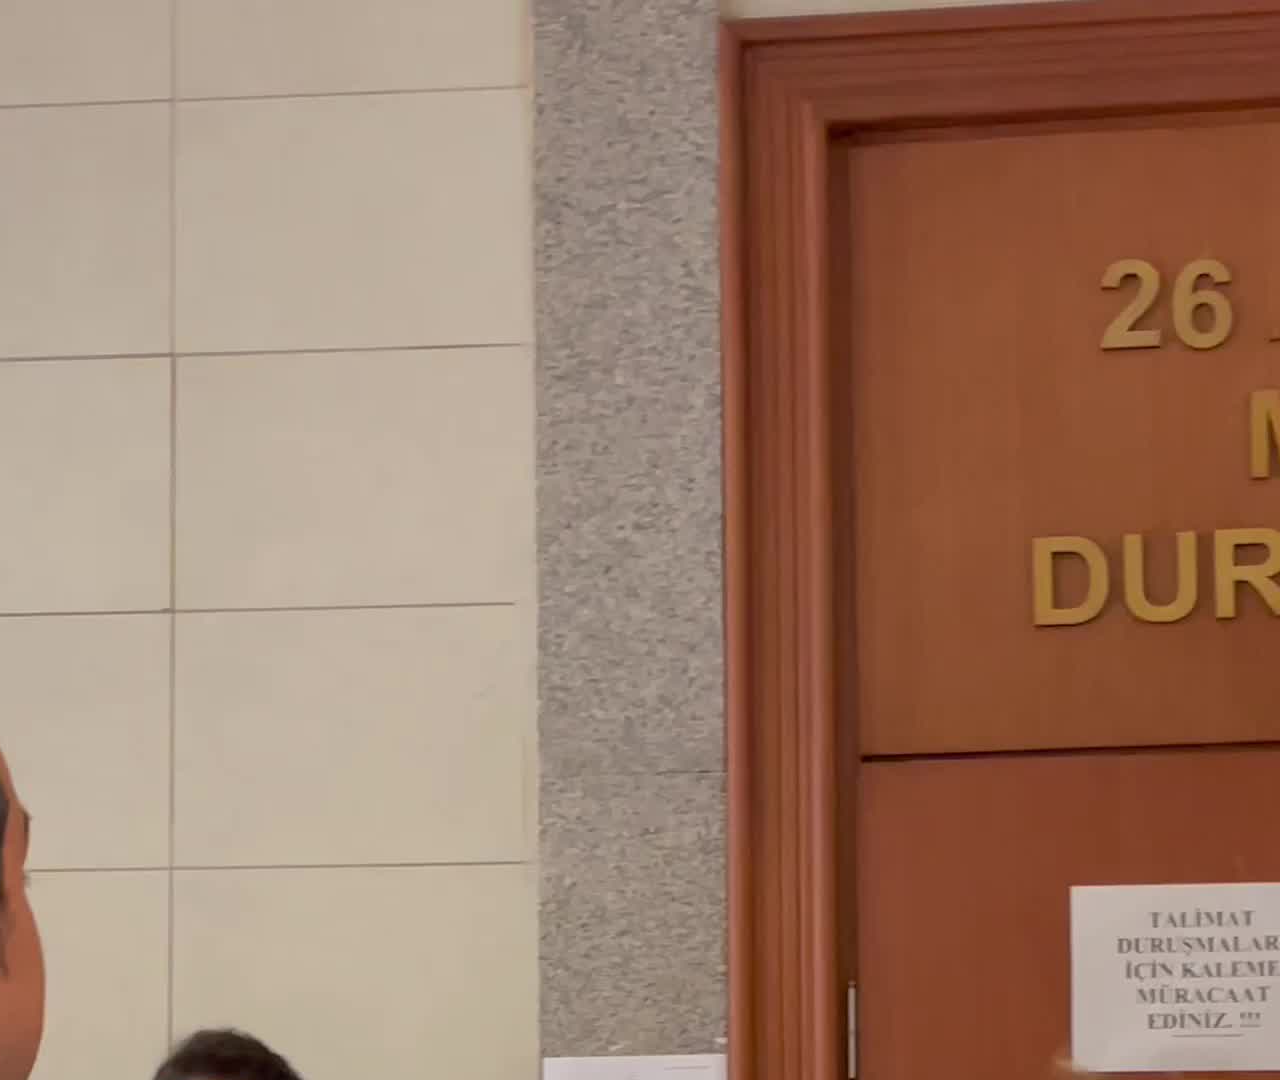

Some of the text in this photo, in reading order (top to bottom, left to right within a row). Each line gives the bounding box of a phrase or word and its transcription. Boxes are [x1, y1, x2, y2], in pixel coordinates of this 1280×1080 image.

[1149, 908, 1256, 928] TALİMAT
[1125, 960, 1280, 981] İÇİN KALEME
[1136, 986, 1271, 1005] MÜRACAAT
